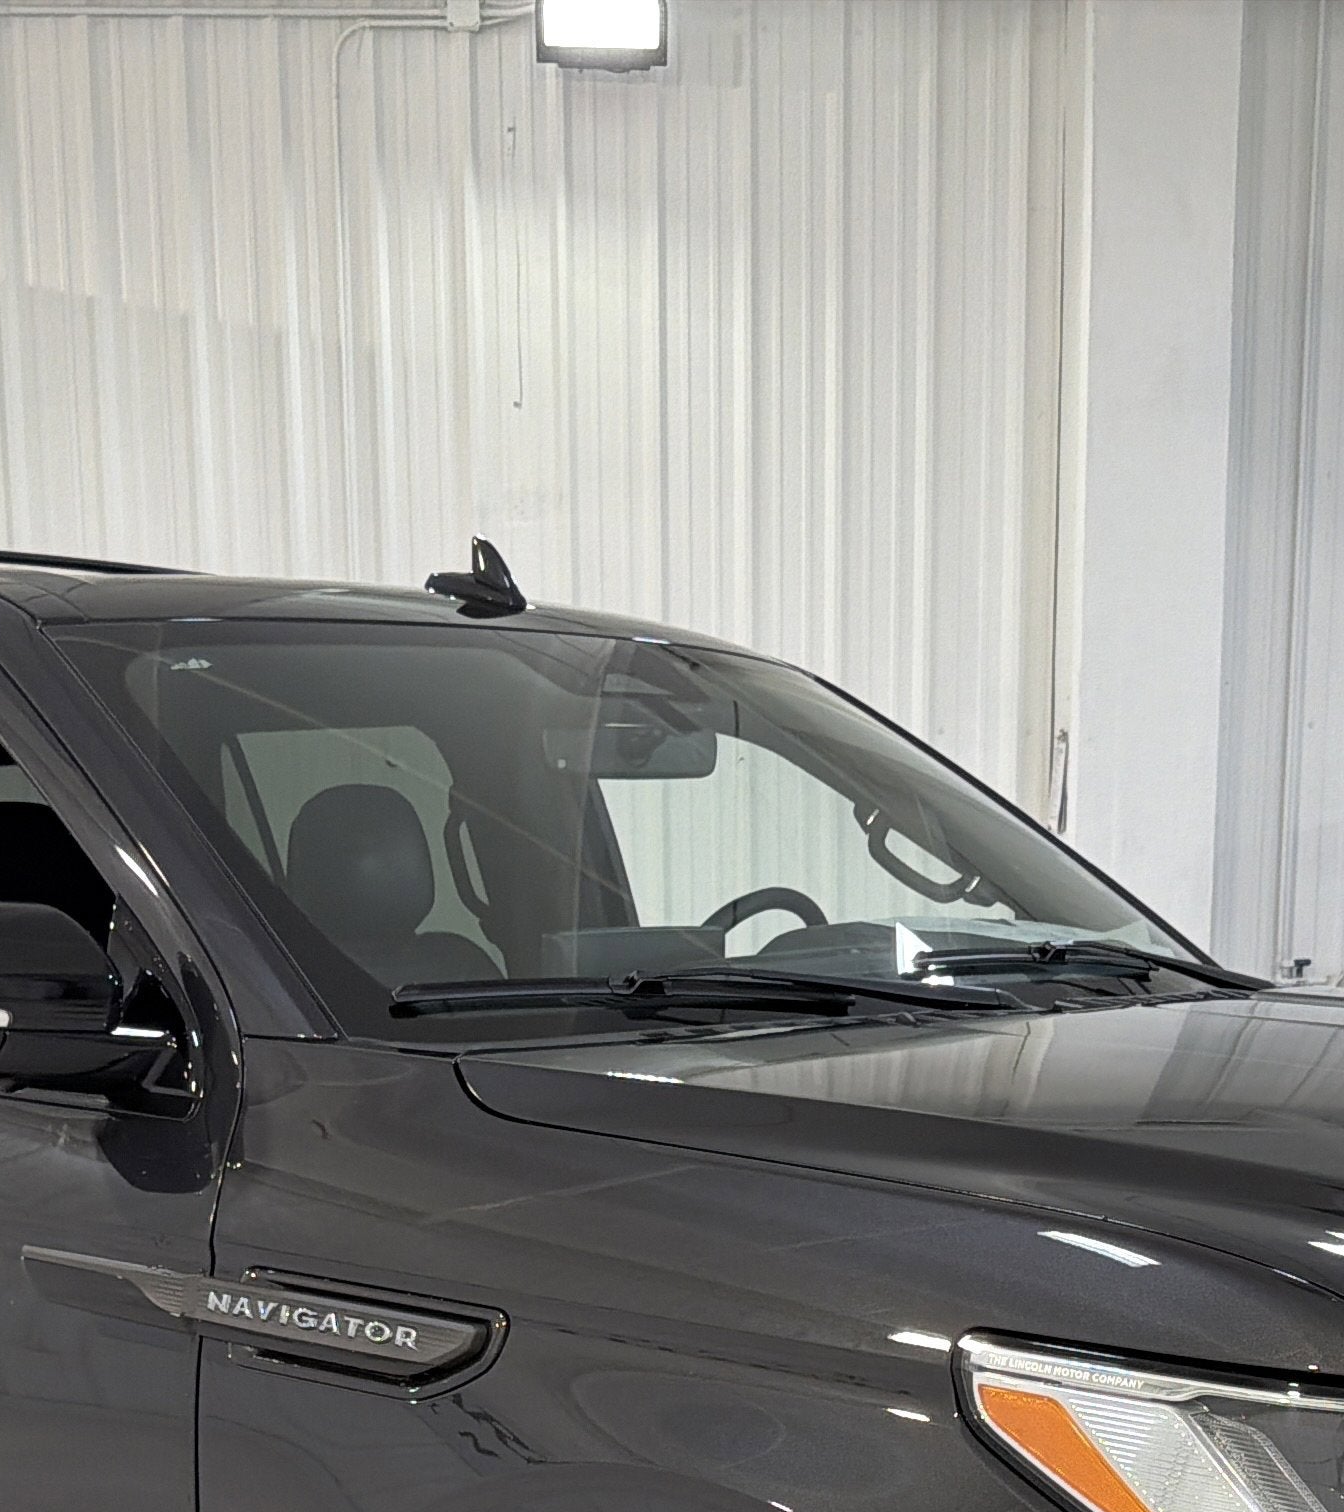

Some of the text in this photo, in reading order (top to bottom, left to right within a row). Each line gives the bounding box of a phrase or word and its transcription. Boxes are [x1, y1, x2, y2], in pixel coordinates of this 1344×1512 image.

[206, 1291, 419, 1352] NAVIGATOR
[988, 1353, 1144, 1389] THE LINCOLN MOTOR COMPANY
